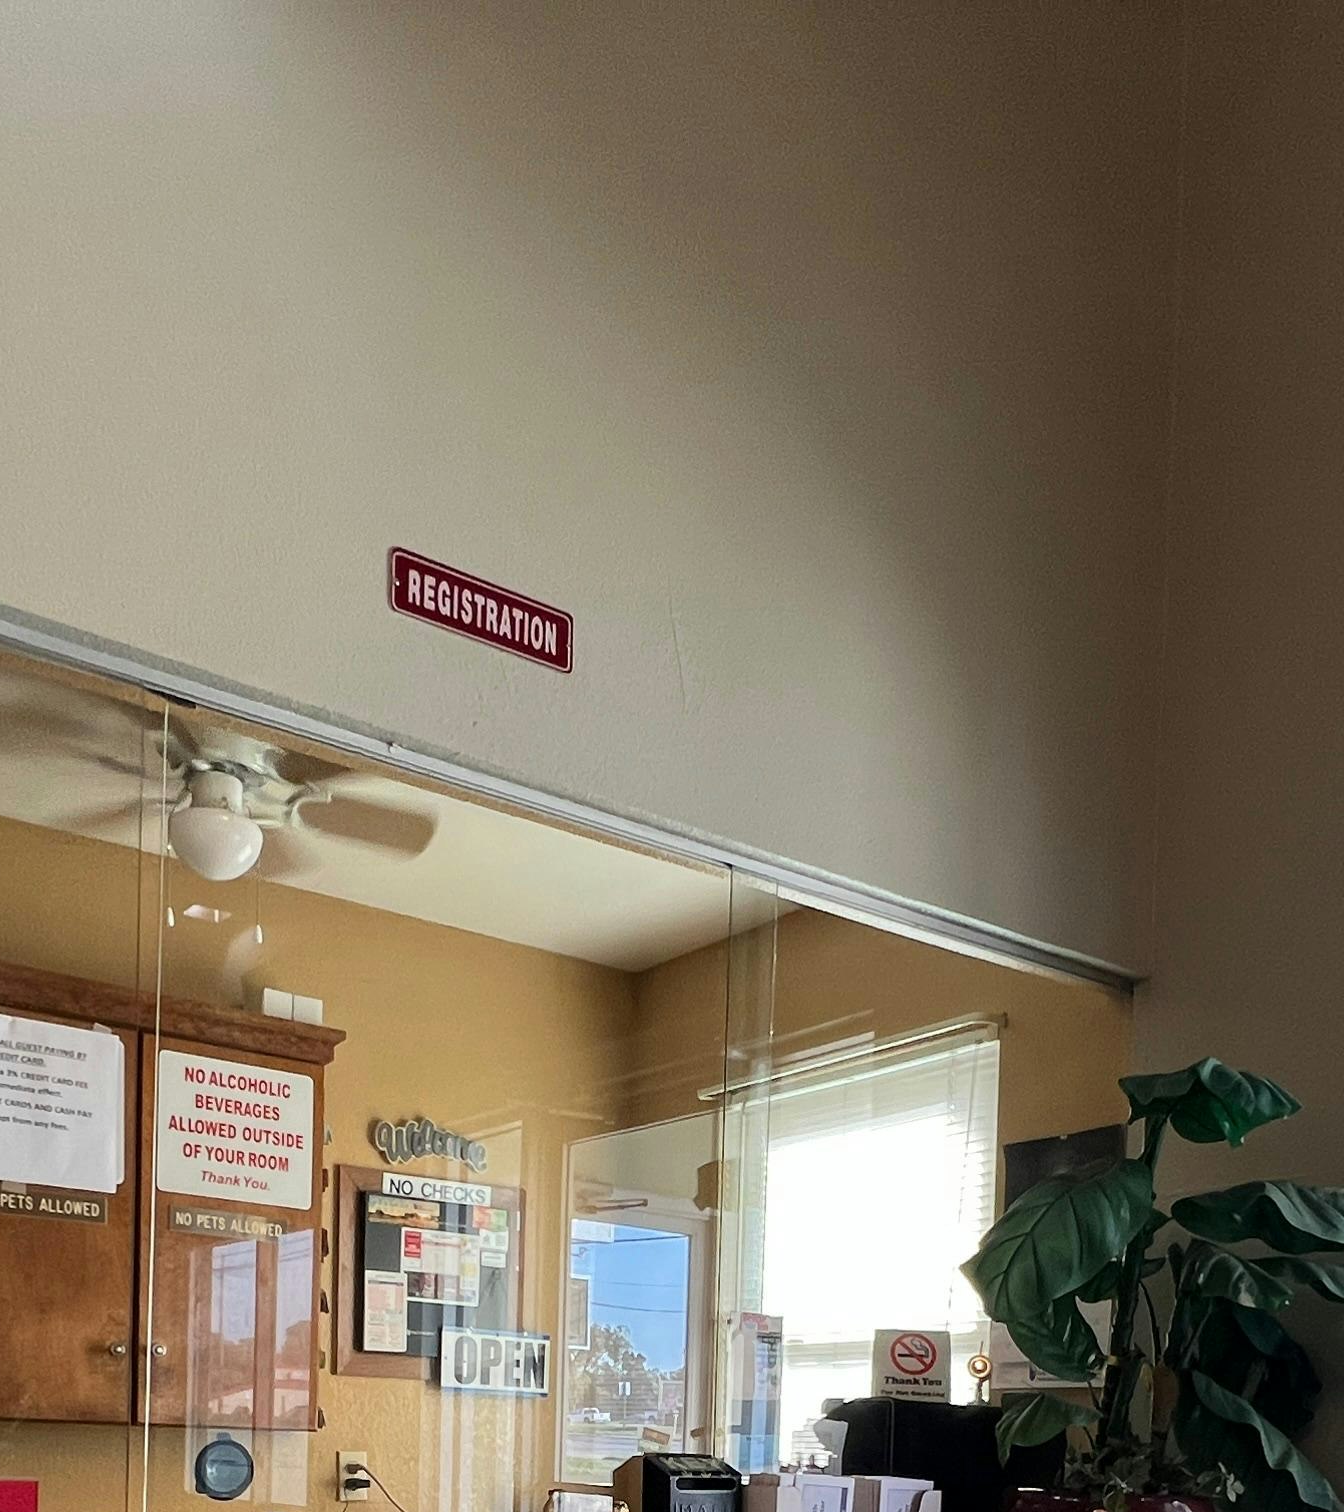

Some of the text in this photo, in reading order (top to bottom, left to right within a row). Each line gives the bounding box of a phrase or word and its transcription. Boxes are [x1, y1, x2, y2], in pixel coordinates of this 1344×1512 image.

[408, 569, 556, 656] REGISTRATION
[0, 1040, 13, 1048] ALL
[21, 1072, 49, 1082] CREDIT
[185, 1067, 290, 1098] NO ALCOHOLIC
[196, 1094, 280, 1121] BEVERAGES
[169, 1115, 304, 1149] ALLOWED OUTSIDE
[183, 1143, 288, 1172] OF YOUR ROOM
[201, 1170, 240, 1186] Thank
[390, 1179, 486, 1204] NO CHECKS
[0, 1194, 33, 1210] PETS
[39, 1198, 99, 1216] ALLOWED
[176, 1212, 282, 1237] NO PETS ALLOWED
[454, 1335, 547, 1389] OPEN
[884, 1376, 942, 1386] Thank You
